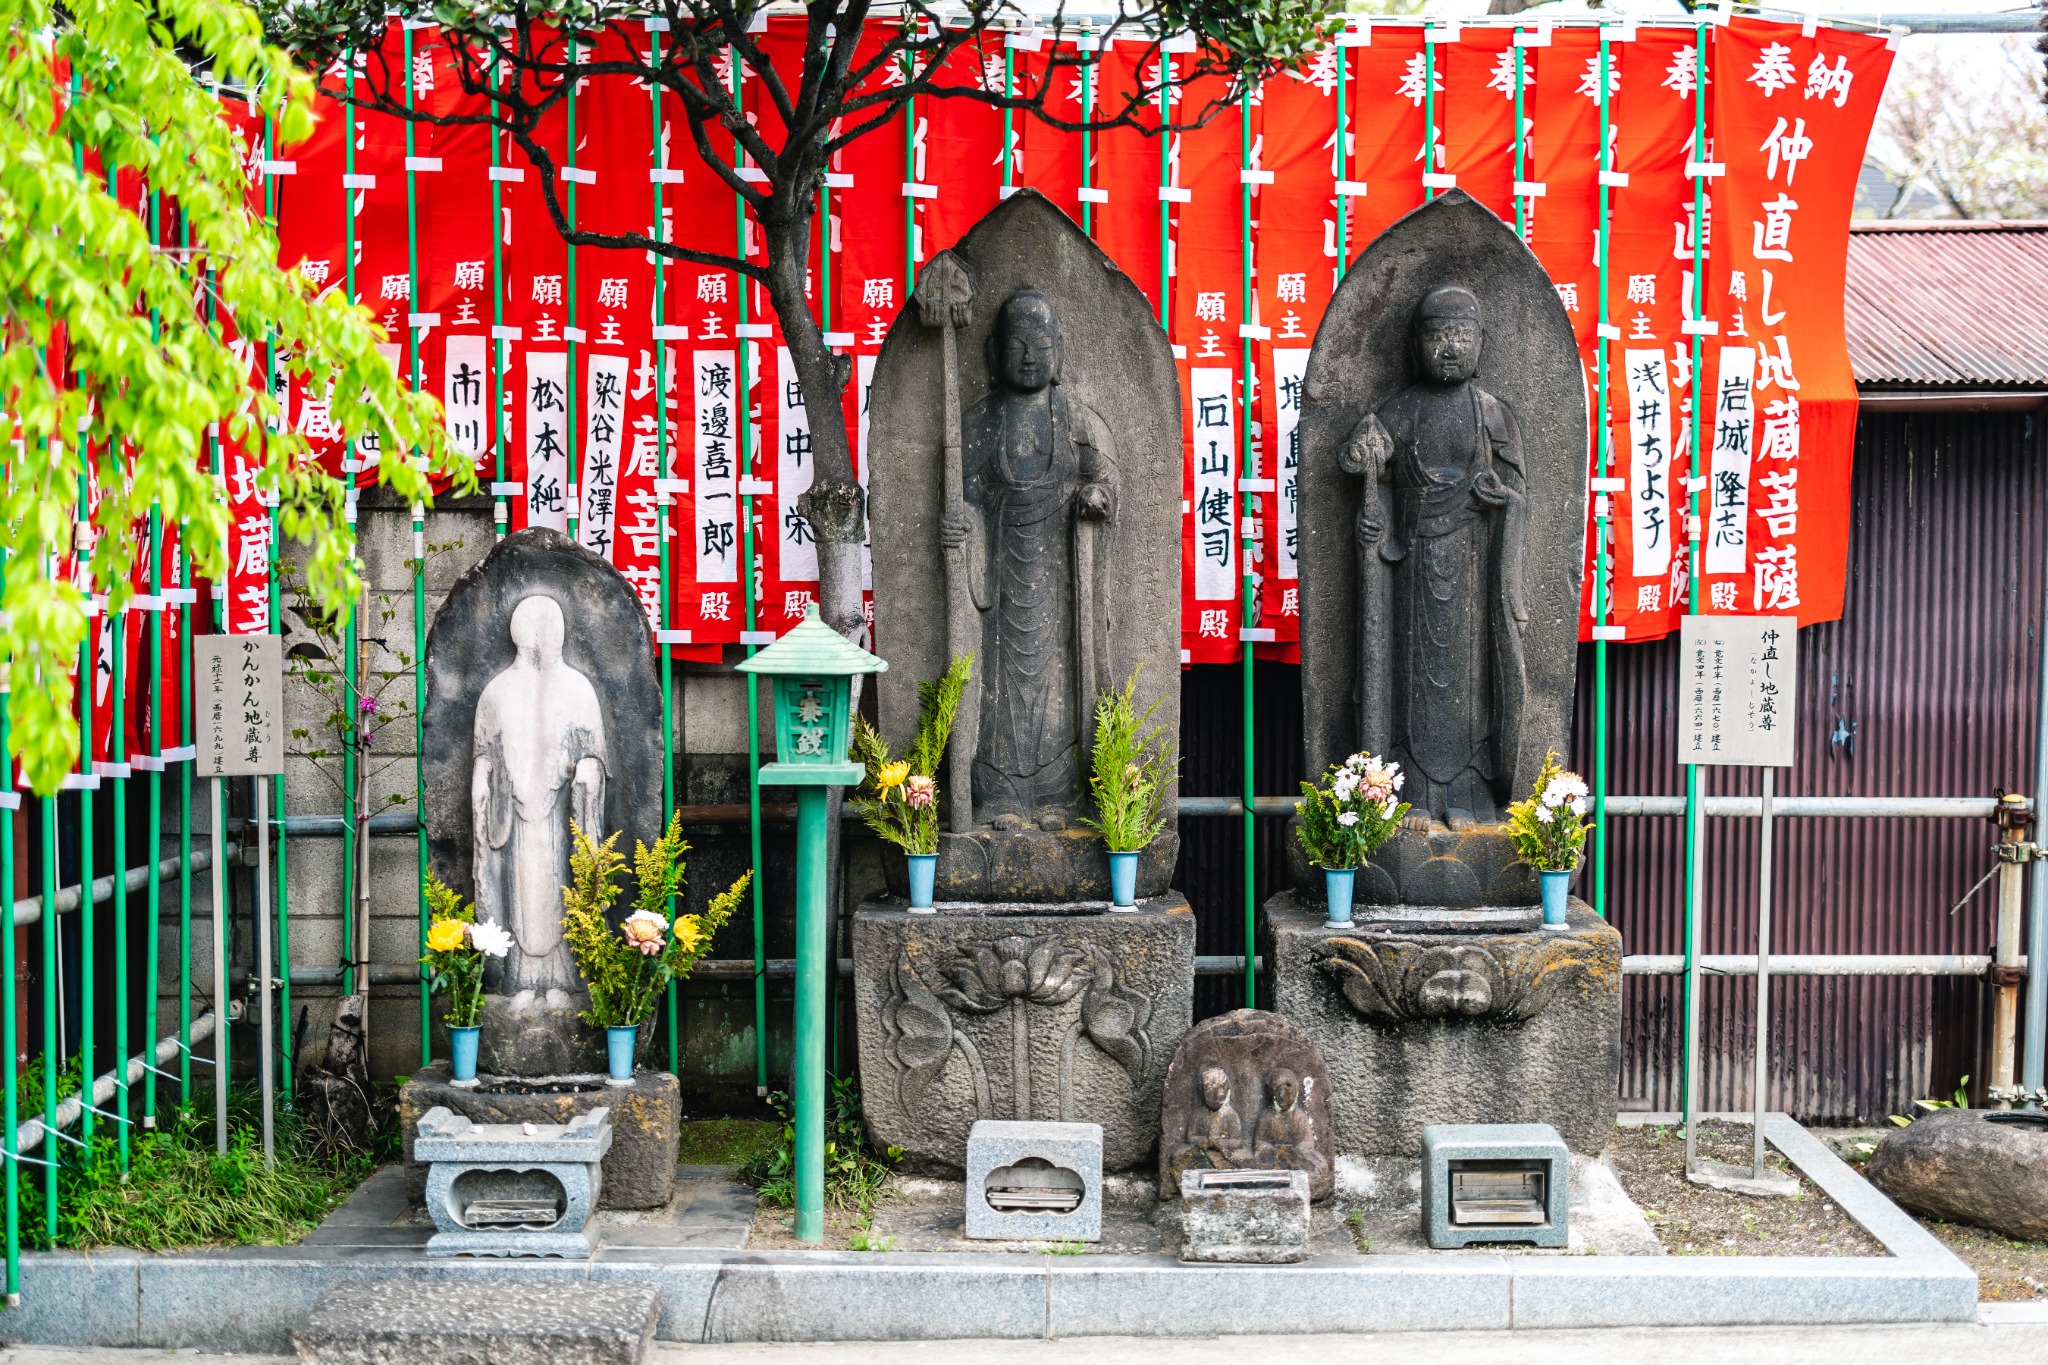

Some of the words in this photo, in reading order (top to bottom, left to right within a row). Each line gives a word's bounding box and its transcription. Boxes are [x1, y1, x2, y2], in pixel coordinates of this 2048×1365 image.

[1746, 41, 1853, 108] 奉納
[451, 260, 486, 326] 願主
[531, 274, 563, 343] 願主
[594, 278, 629, 346] 願主
[697, 273, 728, 341] 願主
[1195, 291, 1226, 359] 願主
[1276, 272, 1307, 339] 願主
[1627, 274, 1657, 340] 願主
[1753, 116, 1813, 611] 仲直し地蔵菩薩
[451, 362, 482, 450] 市川
[1197, 393, 1233, 568] 石山健司
[1632, 360, 1666, 550] 浅井ちよ子
[699, 591, 732, 622] 殿
[1199, 609, 1229, 639] 殿
[1637, 584, 1662, 613] 殿
[1709, 581, 1739, 611] 殿
[242, 640, 263, 764] かんかん地蔵尊
[1758, 629, 1780, 731] 仲直し地蔵尊
